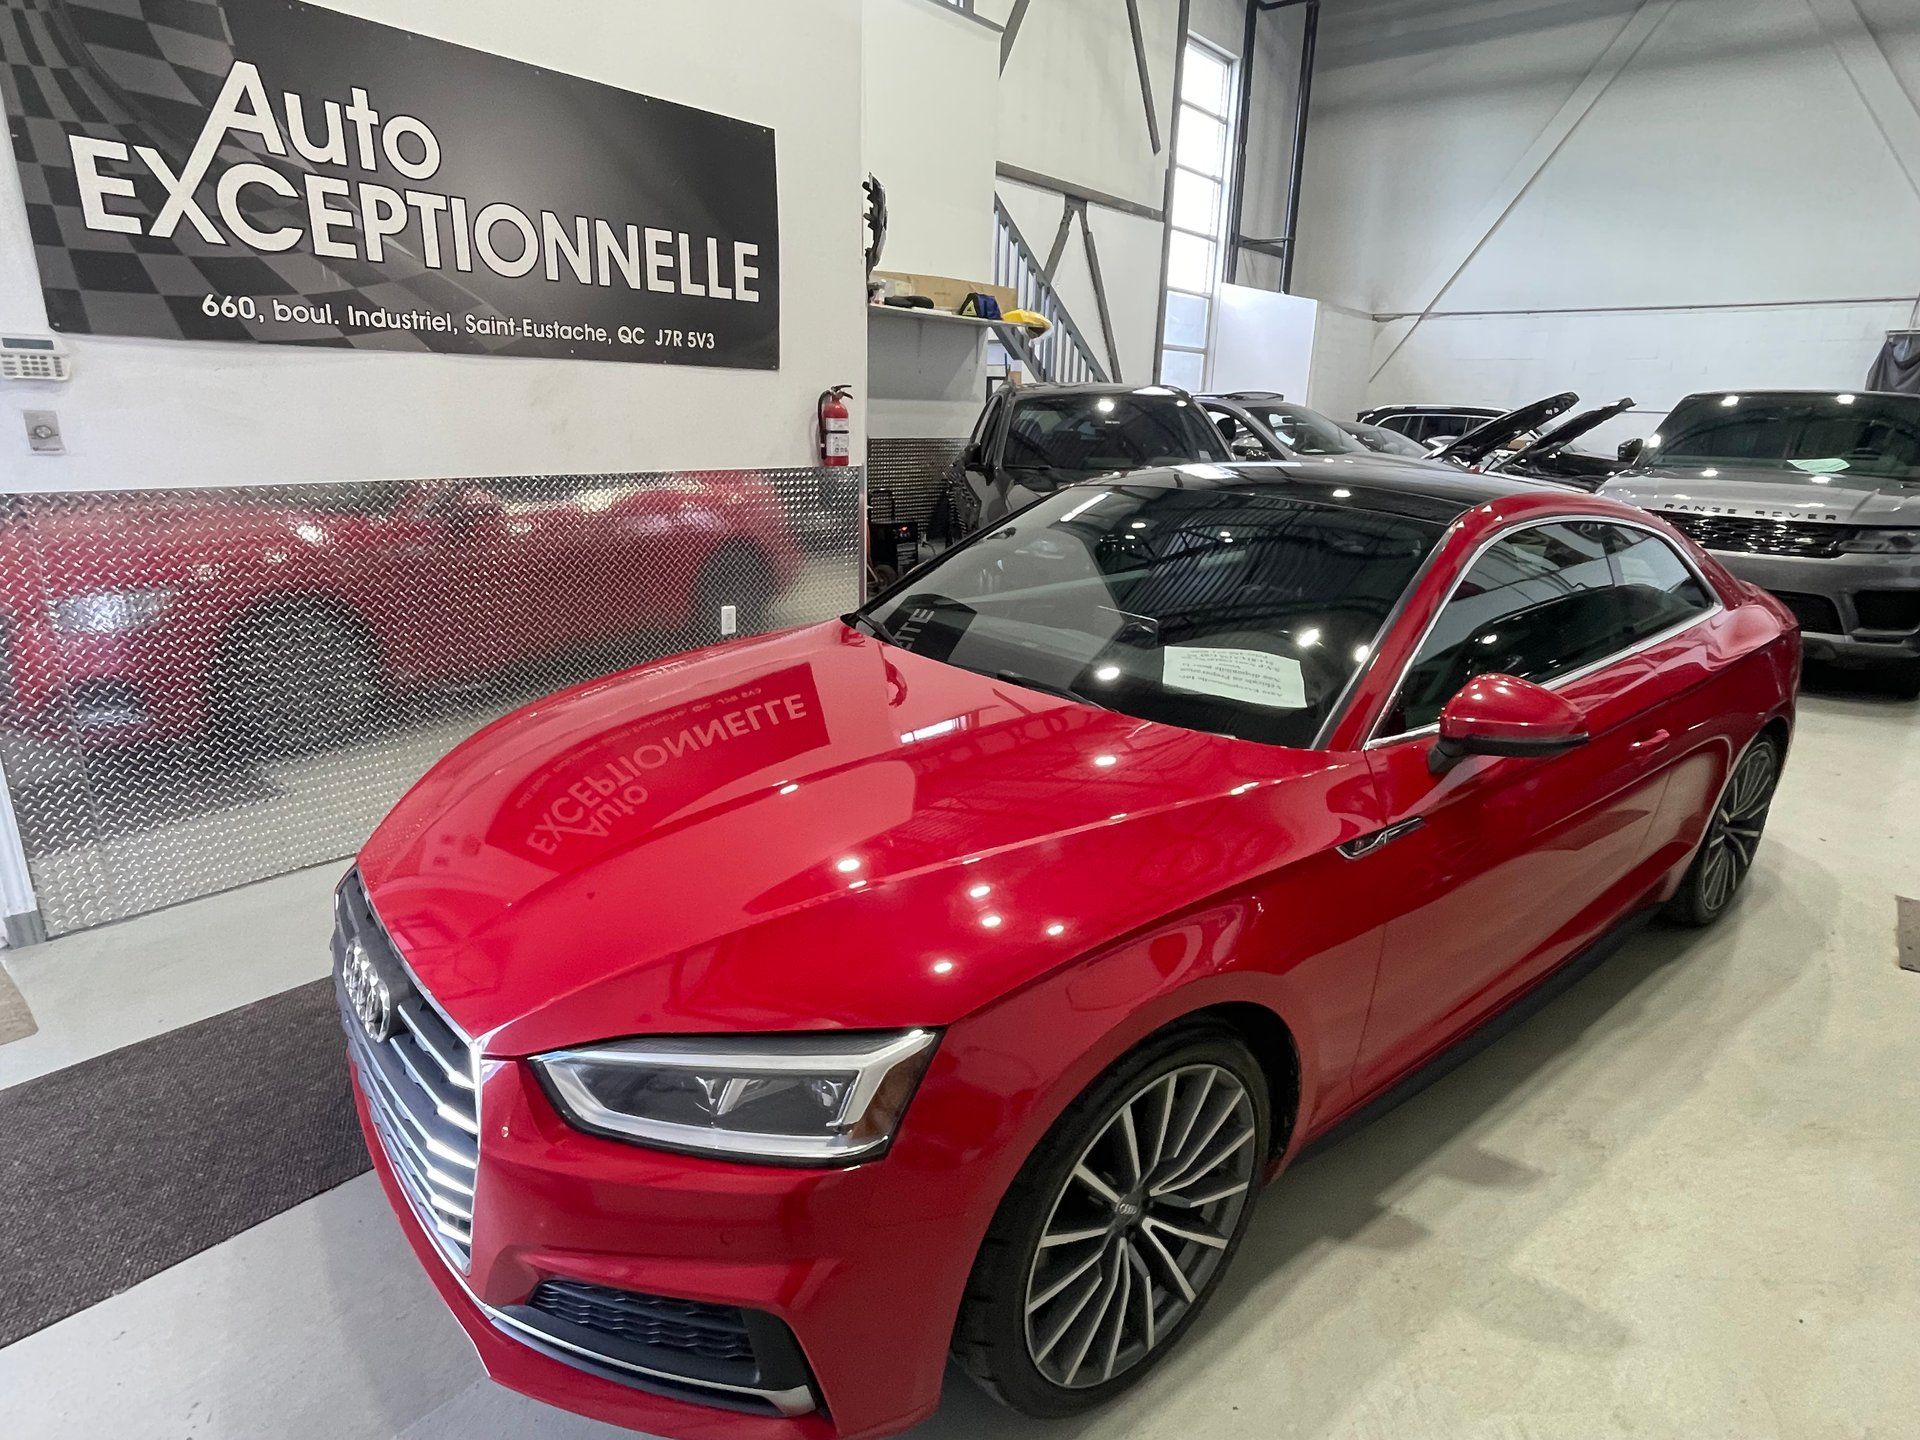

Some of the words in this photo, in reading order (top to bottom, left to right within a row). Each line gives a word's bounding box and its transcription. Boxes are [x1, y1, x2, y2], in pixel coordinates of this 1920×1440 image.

[203, 60, 442, 181] Auto
[68, 134, 760, 303] EXCEPTIONNELLE
[202, 293, 265, 323] 660,
[272, 299, 340, 326] boul.
[347, 305, 458, 335] Industriel,
[464, 313, 612, 344] Saint-Eustache,
[617, 325, 645, 346] QC
[655, 329, 683, 348] J7R
[687, 331, 715, 350] 5V3
